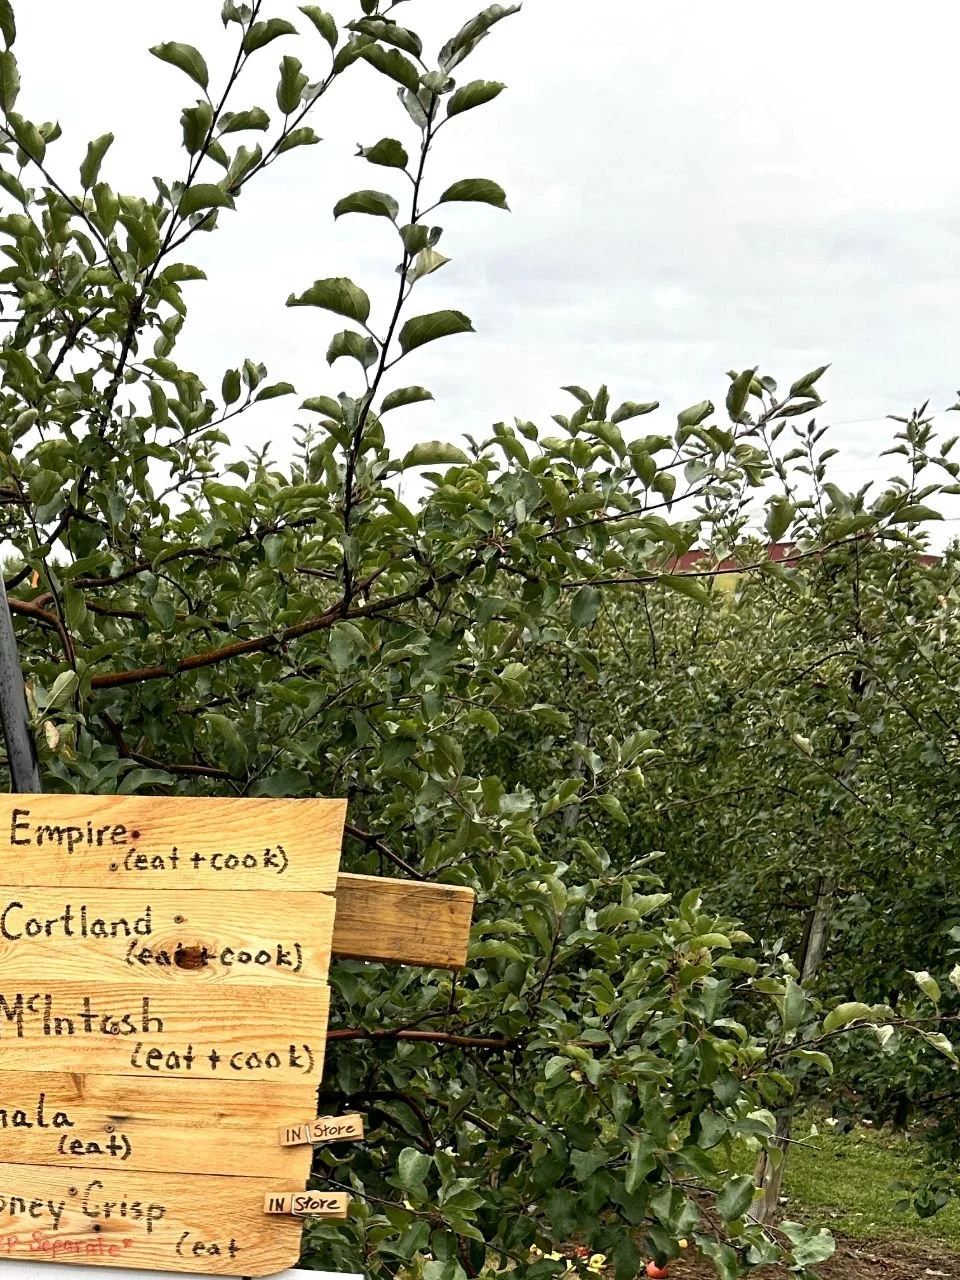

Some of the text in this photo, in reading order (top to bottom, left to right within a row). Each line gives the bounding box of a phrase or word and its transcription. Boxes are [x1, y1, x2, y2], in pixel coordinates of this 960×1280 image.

[10, 808, 128, 854] Empire
[124, 847, 180, 871] (eat
[0, 901, 152, 940] Cortland
[130, 1042, 195, 1070] (eat
[57, 1134, 132, 1160] (eat)
[286, 1126, 301, 1142] IN
[82, 1180, 166, 1233] Crisp
[269, 1196, 341, 1211] IN Store
[176, 1231, 241, 1258] (eat
